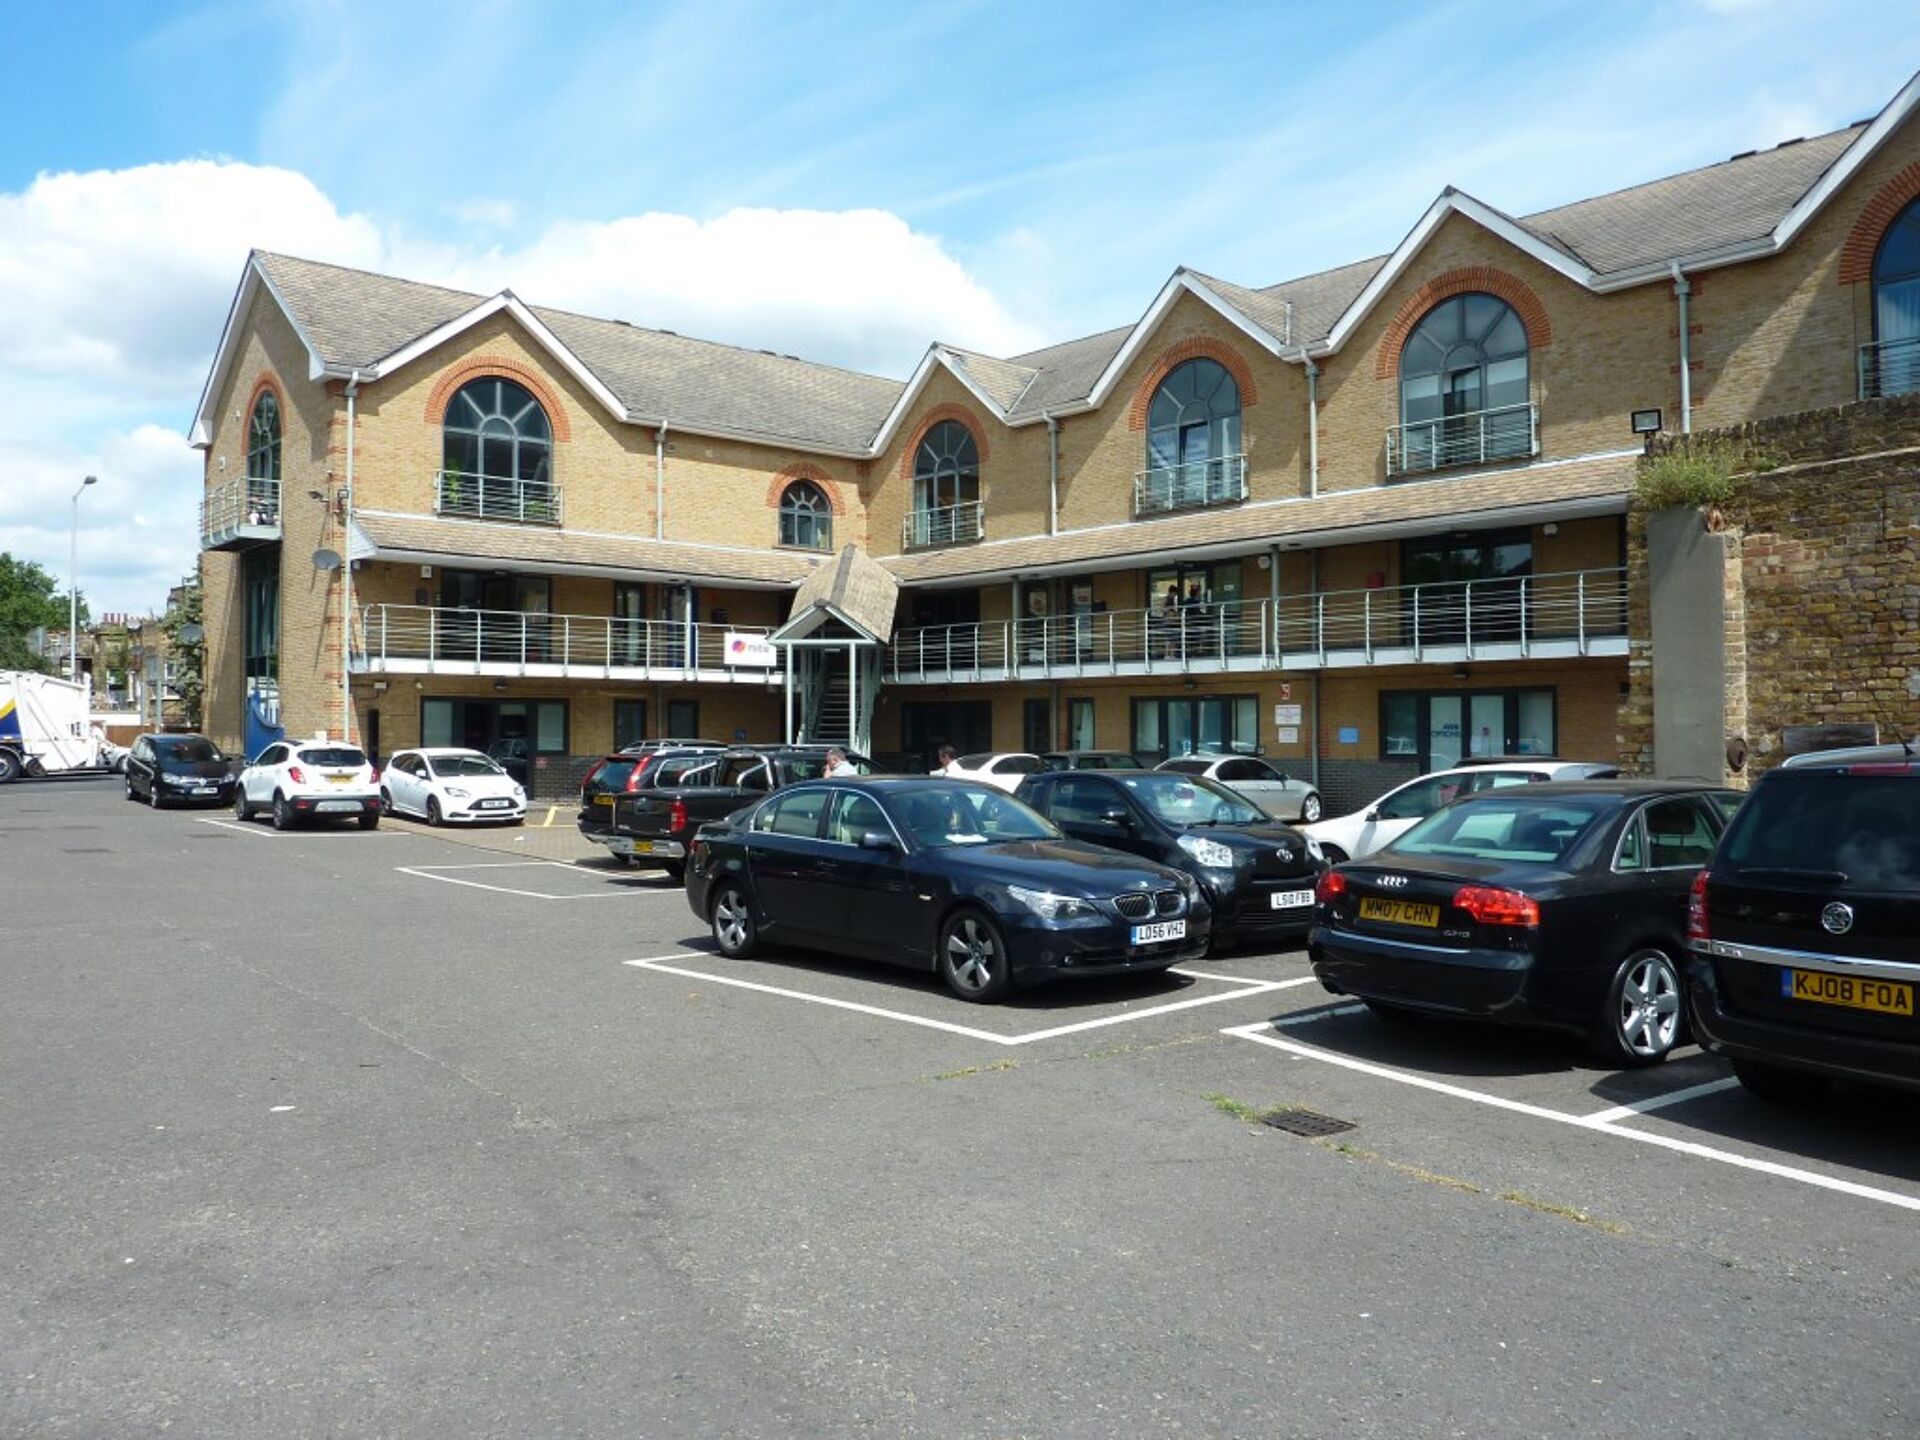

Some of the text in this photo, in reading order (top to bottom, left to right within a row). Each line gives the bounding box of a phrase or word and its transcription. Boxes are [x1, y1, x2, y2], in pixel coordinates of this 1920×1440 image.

[1403, 904, 1433, 922] CHN
[1139, 925, 1164, 940] LO56
[1795, 974, 1908, 1010] KJ08 FOA
